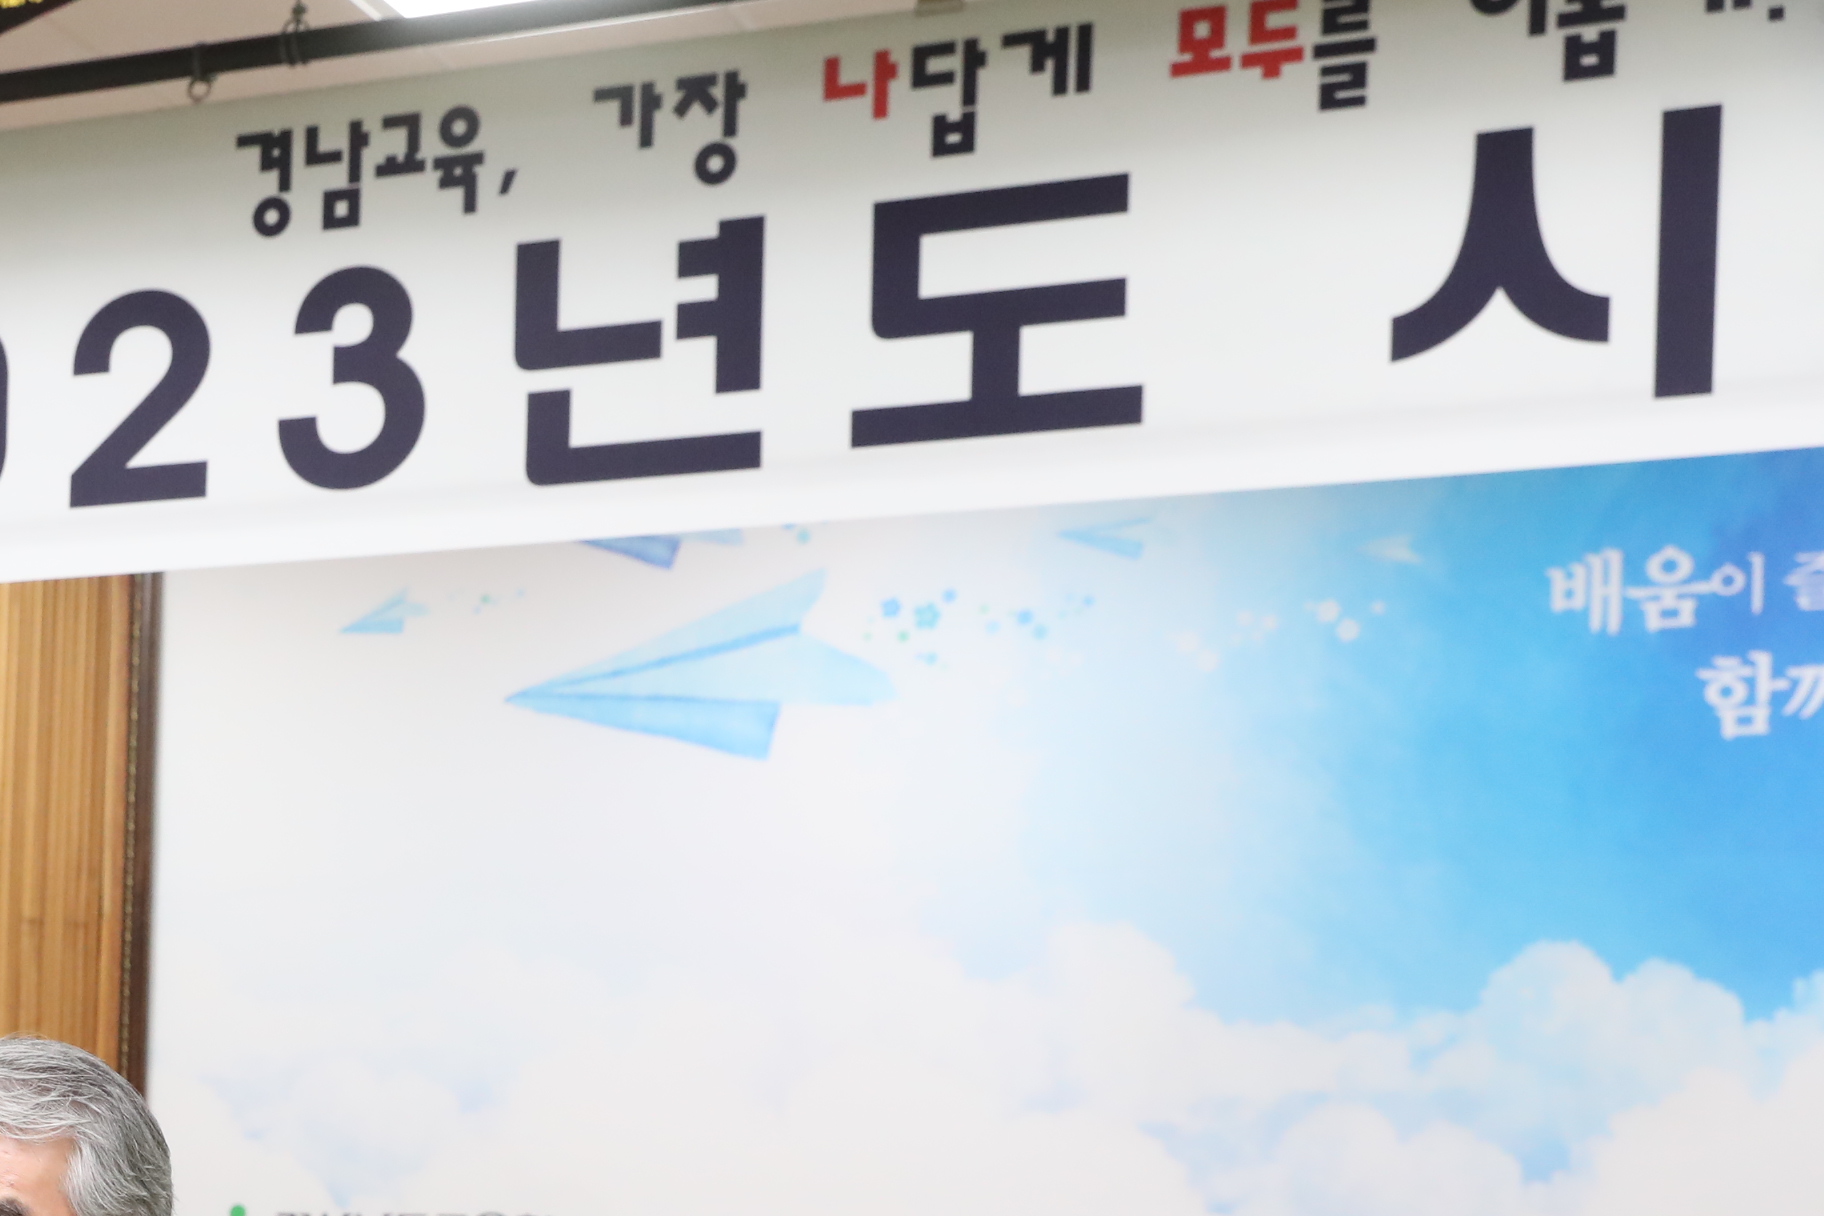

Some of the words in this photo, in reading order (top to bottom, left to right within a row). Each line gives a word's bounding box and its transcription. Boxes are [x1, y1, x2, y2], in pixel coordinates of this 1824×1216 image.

[236, 105, 518, 237] 경남교육,
[594, 69, 746, 186] 가장
[822, 22, 1093, 157] 나답게
[1170, 0, 1377, 113] 모두를
[1391, 104, 1723, 398] 시
[1545, 545, 1766, 636] 배움이
